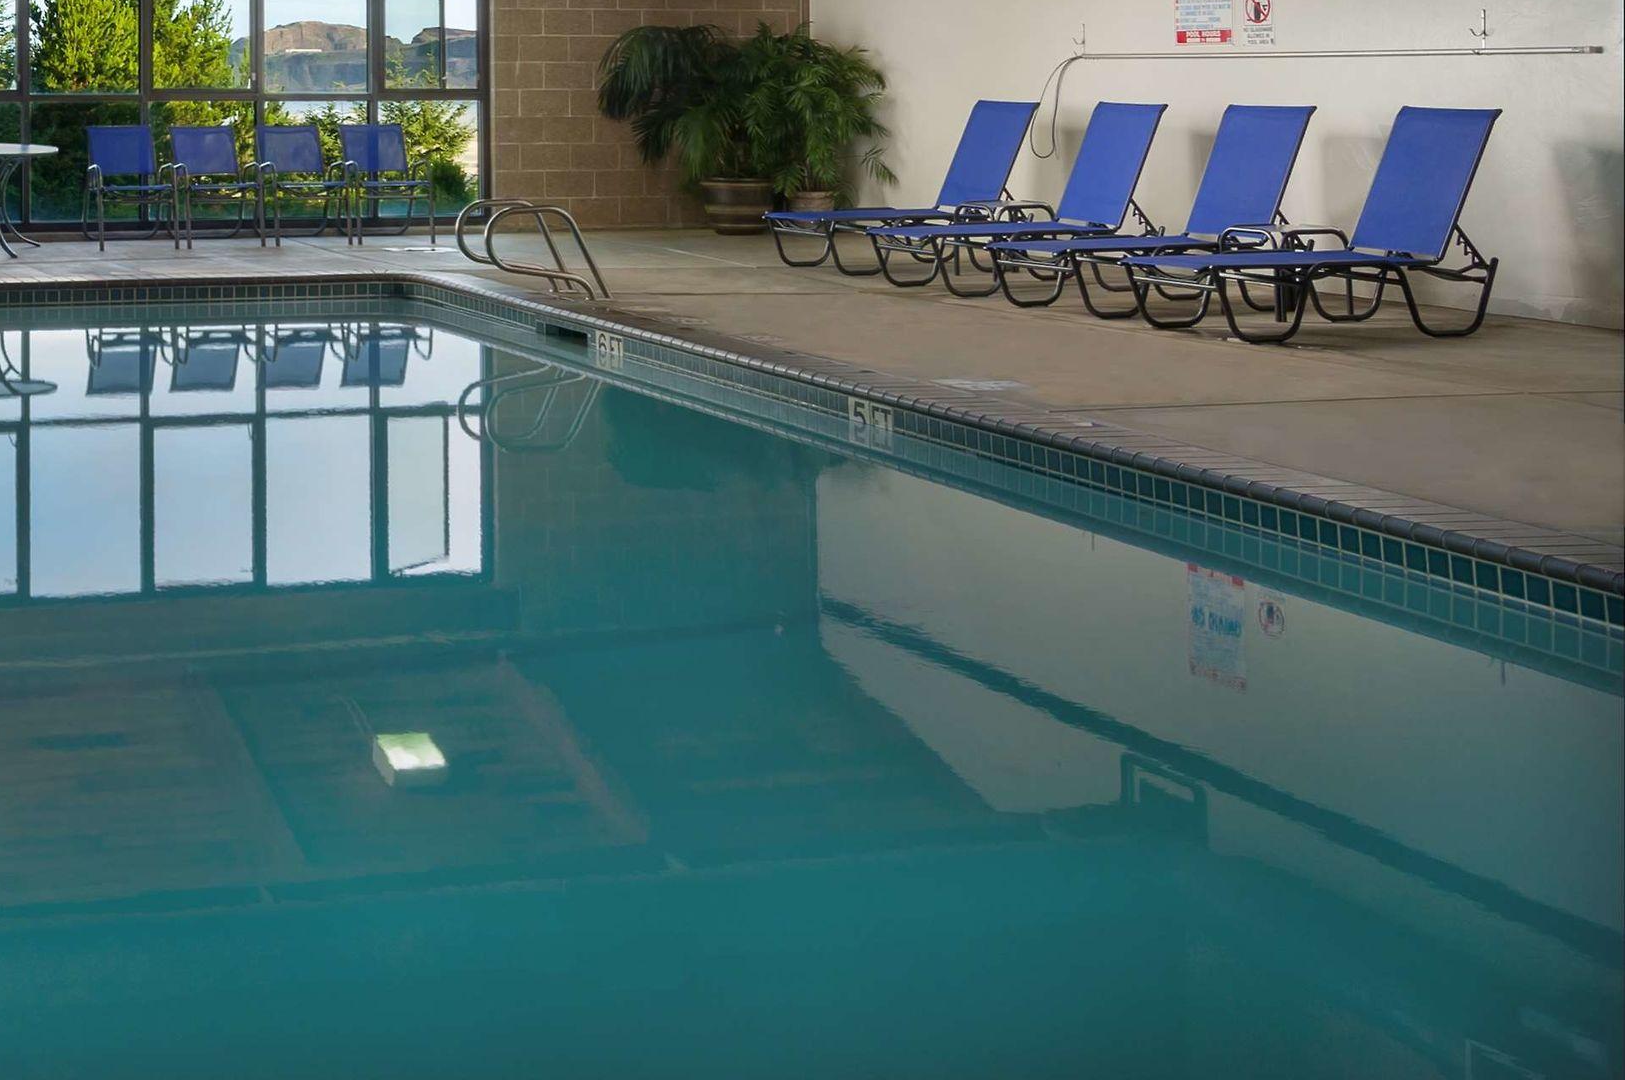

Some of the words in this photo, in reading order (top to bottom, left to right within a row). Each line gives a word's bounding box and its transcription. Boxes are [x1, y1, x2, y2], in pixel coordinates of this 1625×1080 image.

[598, 333, 608, 352] 6
[609, 336, 623, 356] FT
[854, 401, 867, 425] 5
[872, 405, 892, 431] FT
